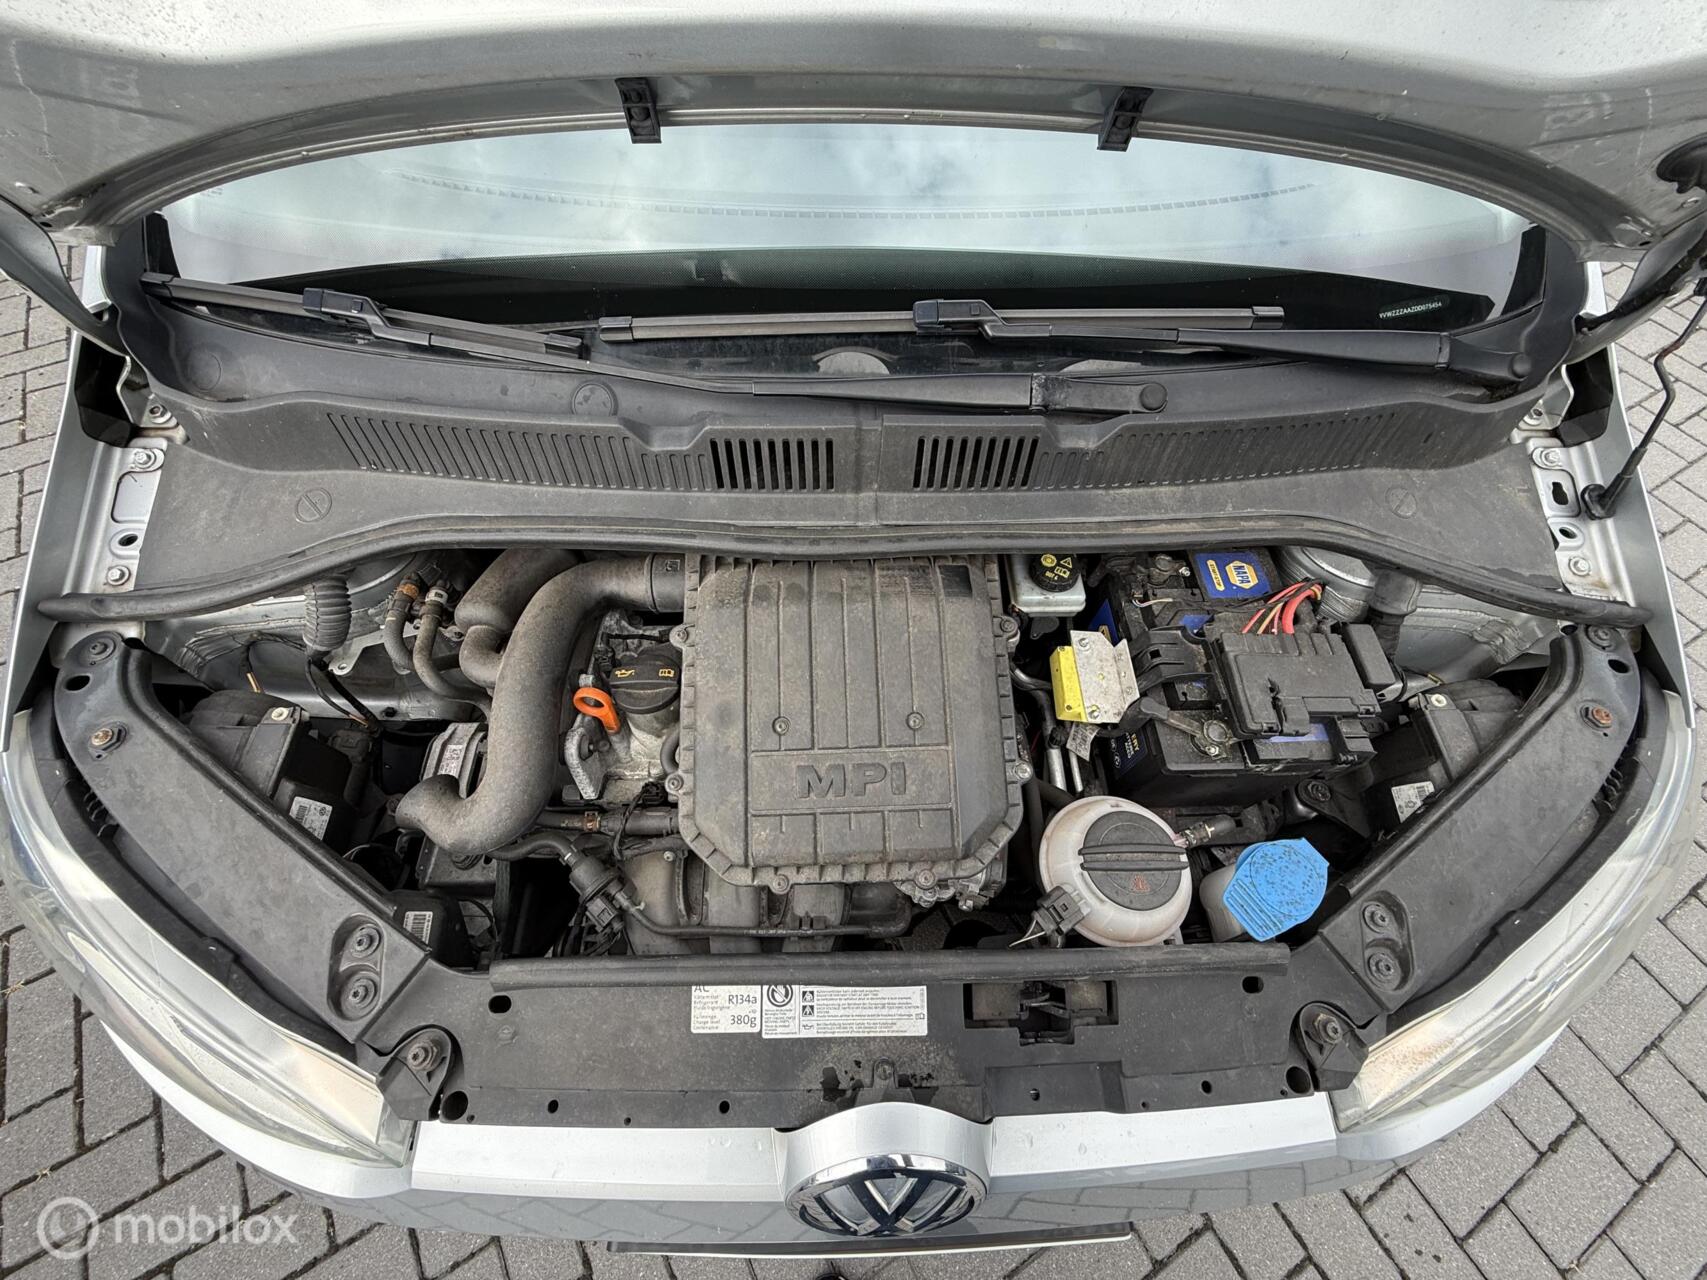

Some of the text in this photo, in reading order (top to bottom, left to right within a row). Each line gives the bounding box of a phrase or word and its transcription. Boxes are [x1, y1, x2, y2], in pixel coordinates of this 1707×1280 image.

[1232, 564, 1252, 585] NAPA
[796, 761, 907, 799] MPI
[728, 994, 758, 1005] R134a
[730, 1014, 758, 1029] 380g
